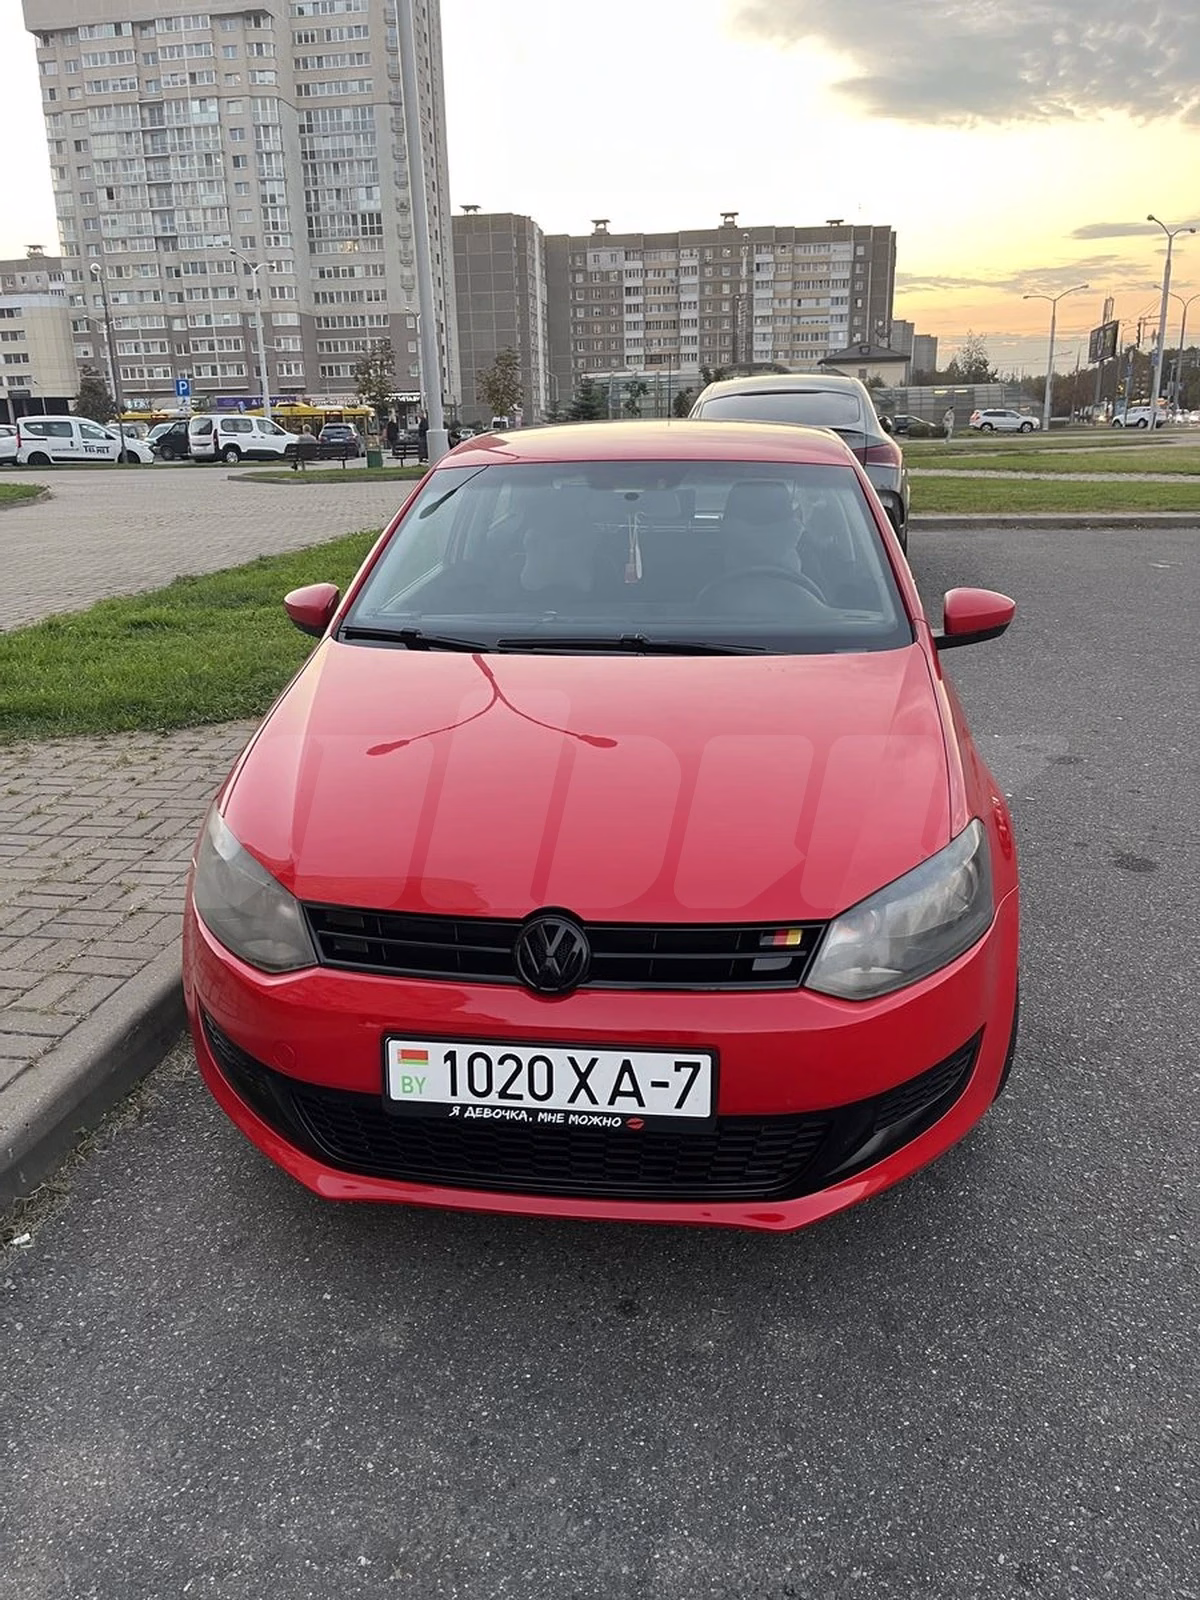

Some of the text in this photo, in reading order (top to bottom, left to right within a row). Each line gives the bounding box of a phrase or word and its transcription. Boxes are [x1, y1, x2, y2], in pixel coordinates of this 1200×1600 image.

[178, 381, 188, 395] P
[401, 1075, 427, 1095] BY
[448, 1105, 461, 1117] Я
[537, 1112, 565, 1123] МНЕ
[568, 1114, 622, 1128] МОЖНО
